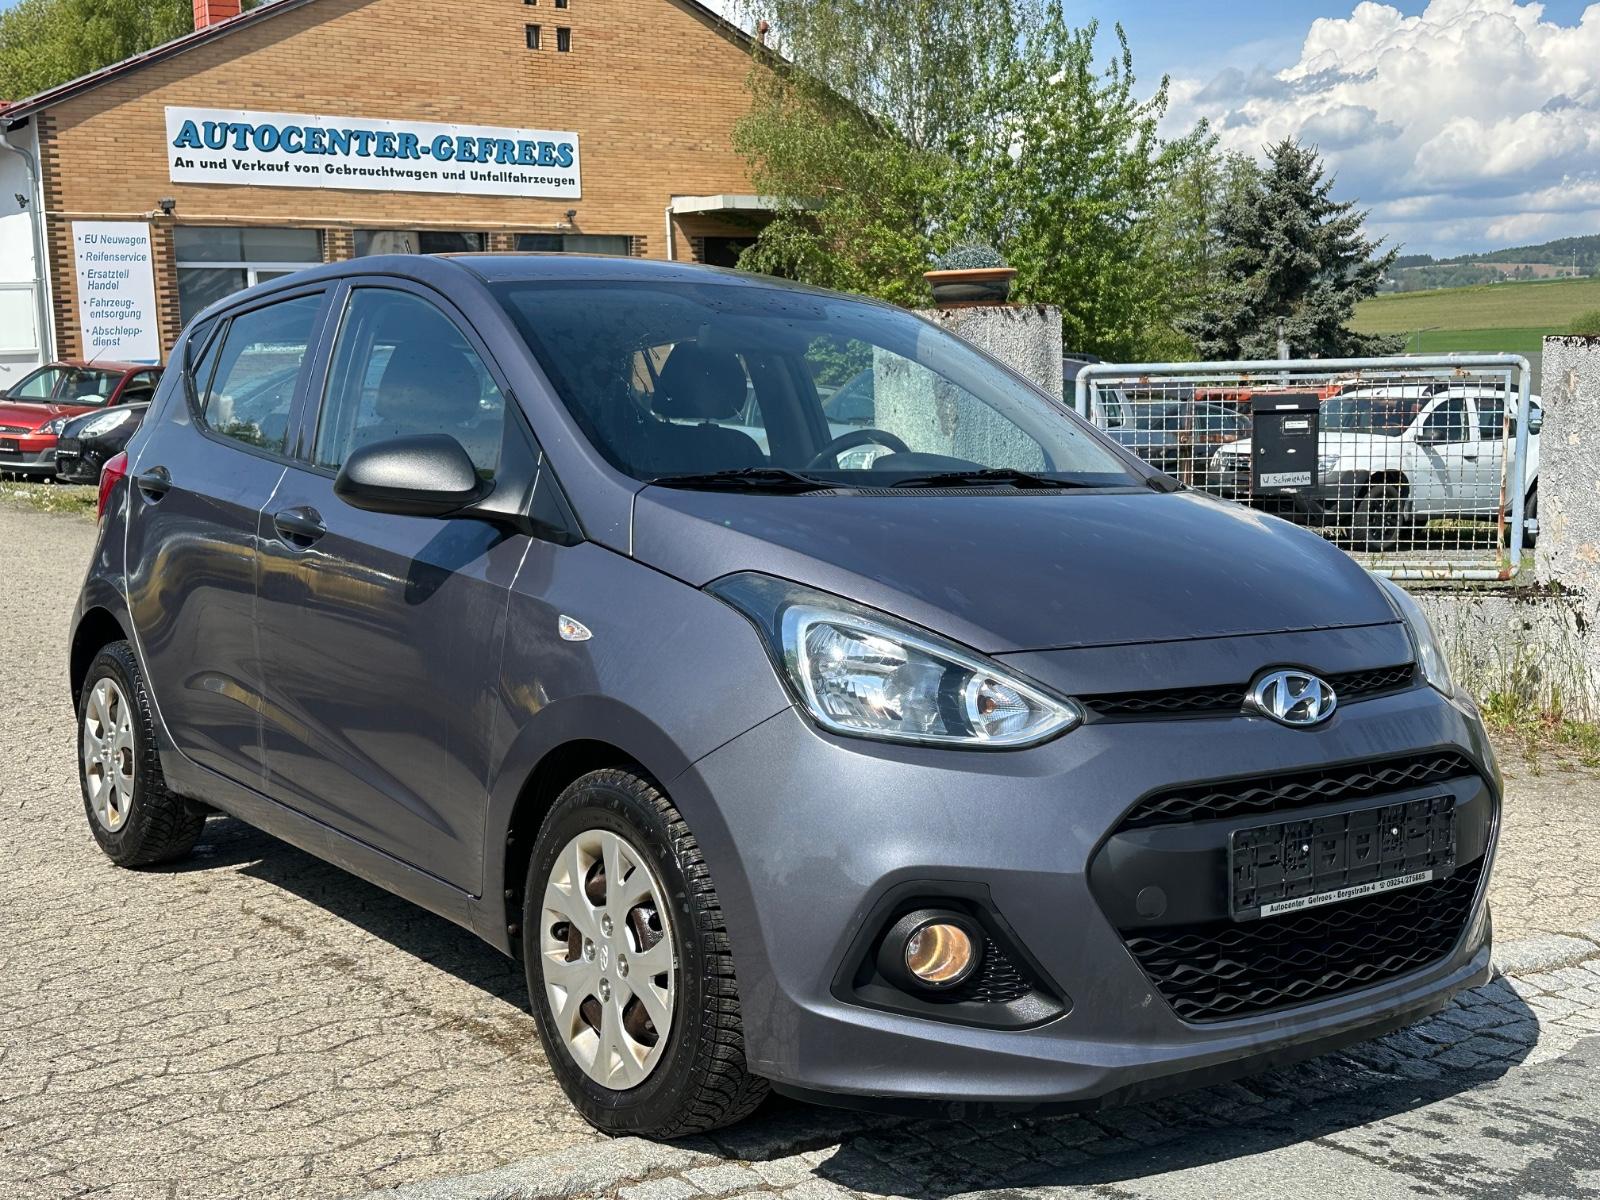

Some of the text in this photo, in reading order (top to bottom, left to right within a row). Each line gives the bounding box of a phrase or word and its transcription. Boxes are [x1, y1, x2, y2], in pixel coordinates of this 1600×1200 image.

[173, 120, 574, 168] AUTOCENTER-GEFREES
[174, 157, 575, 187] An und Verkauf von Gebrauchtwagen und Unfallfahrzeugen
[84, 234, 147, 246] EU Neuwagen
[86, 252, 147, 261] Reifenservice
[87, 269, 129, 278] Ersatzteil
[88, 281, 119, 290] Handel
[90, 298, 135, 309] Fahrzeug-
[90, 310, 141, 320] entsorgung
[91, 326, 142, 337] Abschlepp-
[93, 337, 120, 346] dienst
[1269, 899, 1305, 913] Autocenter
[1308, 894, 1332, 904] Gefrees
[1337, 886, 1370, 898] Bergstraße
